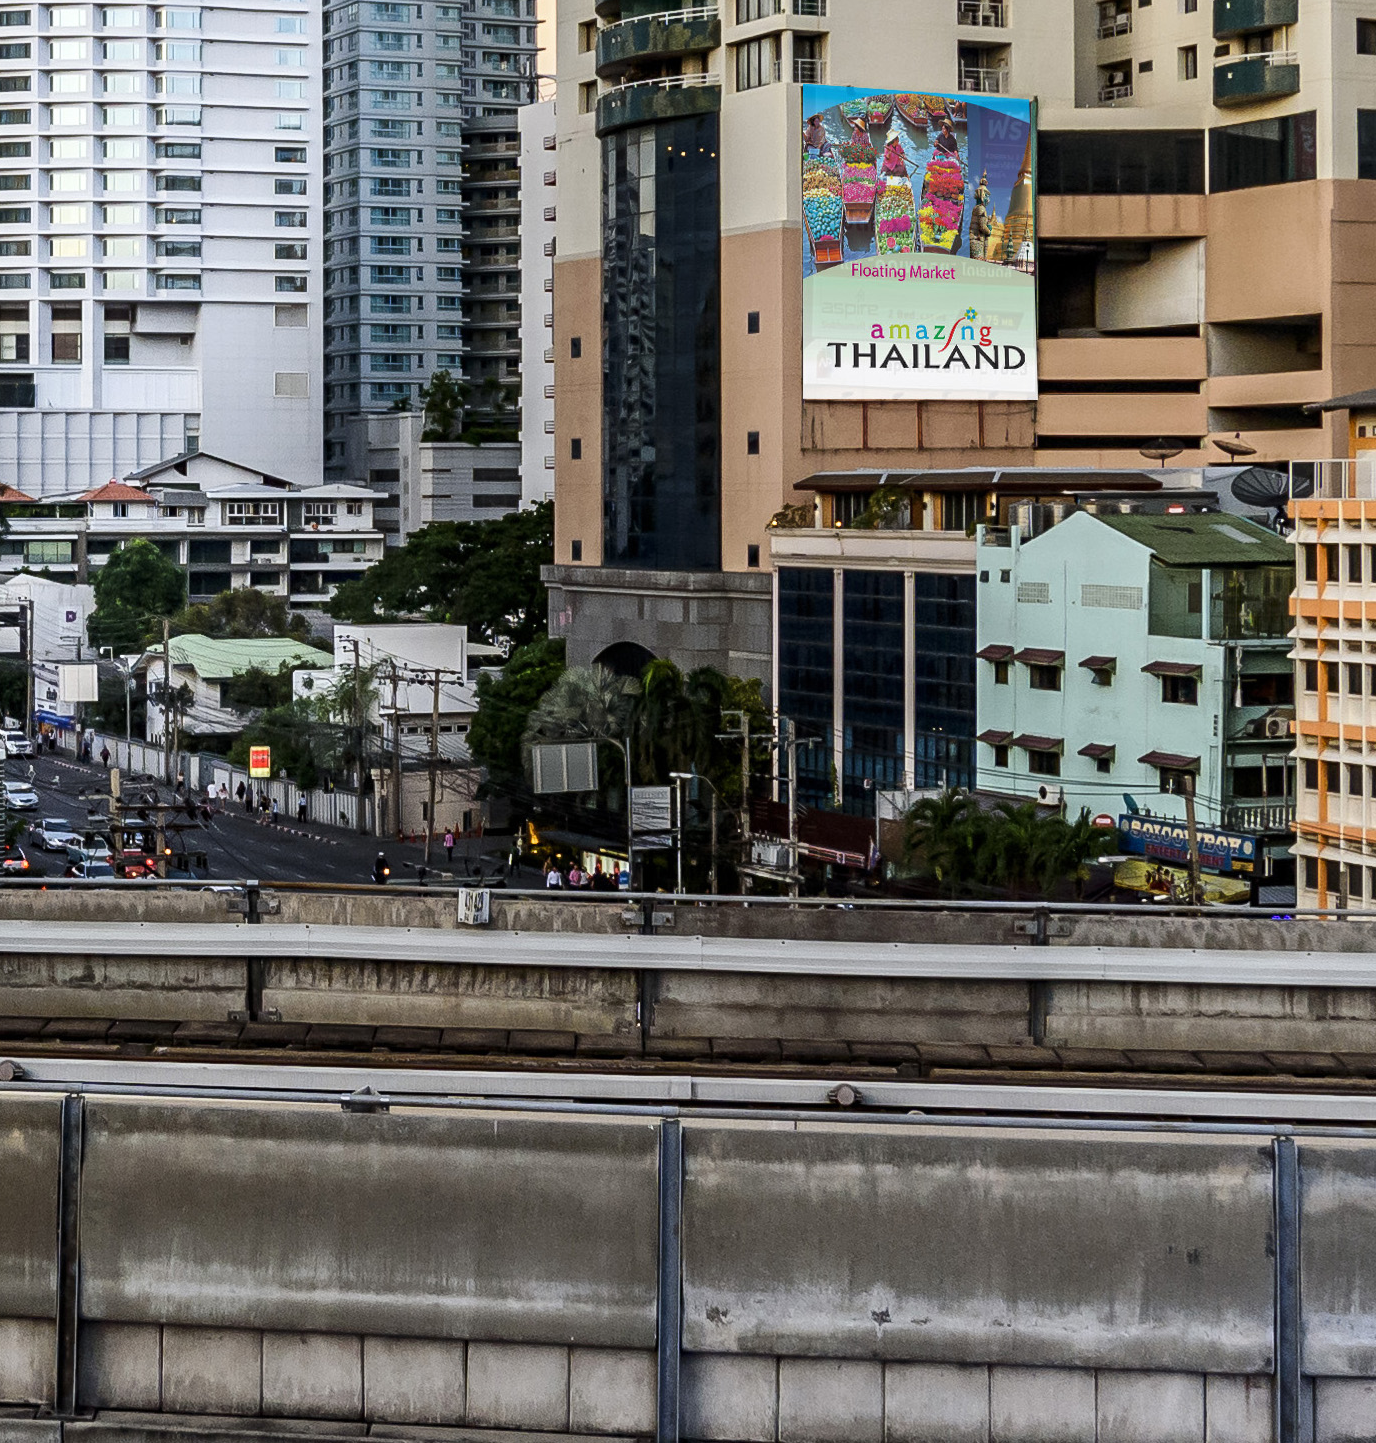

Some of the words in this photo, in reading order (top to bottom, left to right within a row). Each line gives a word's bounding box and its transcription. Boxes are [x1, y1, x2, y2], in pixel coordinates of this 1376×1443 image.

[852, 263, 906, 281] Floating
[910, 265, 956, 280] Market
[871, 314, 993, 353] amazing
[827, 342, 1026, 369] THAILAND
[1145, 843, 1226, 867] ENTERTAMENT
